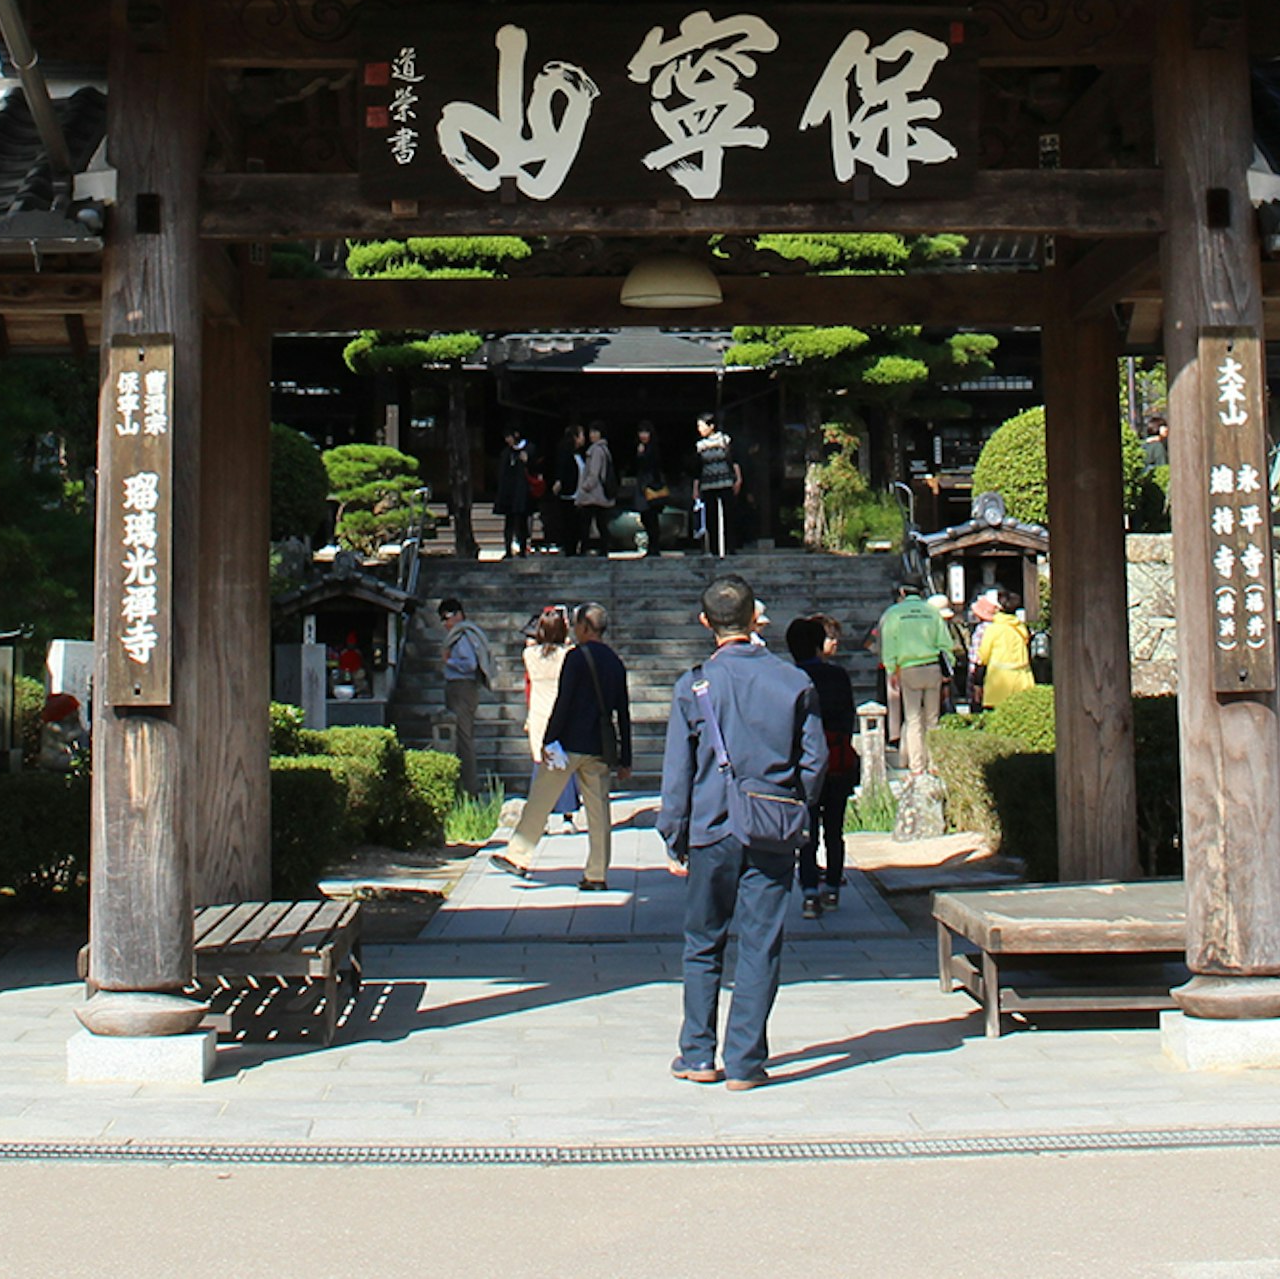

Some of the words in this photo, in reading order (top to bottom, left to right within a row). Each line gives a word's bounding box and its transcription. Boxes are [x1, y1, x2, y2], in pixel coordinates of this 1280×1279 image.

[144, 369, 168, 436] 曹洞宗
[1217, 356, 1248, 426] 大本山
